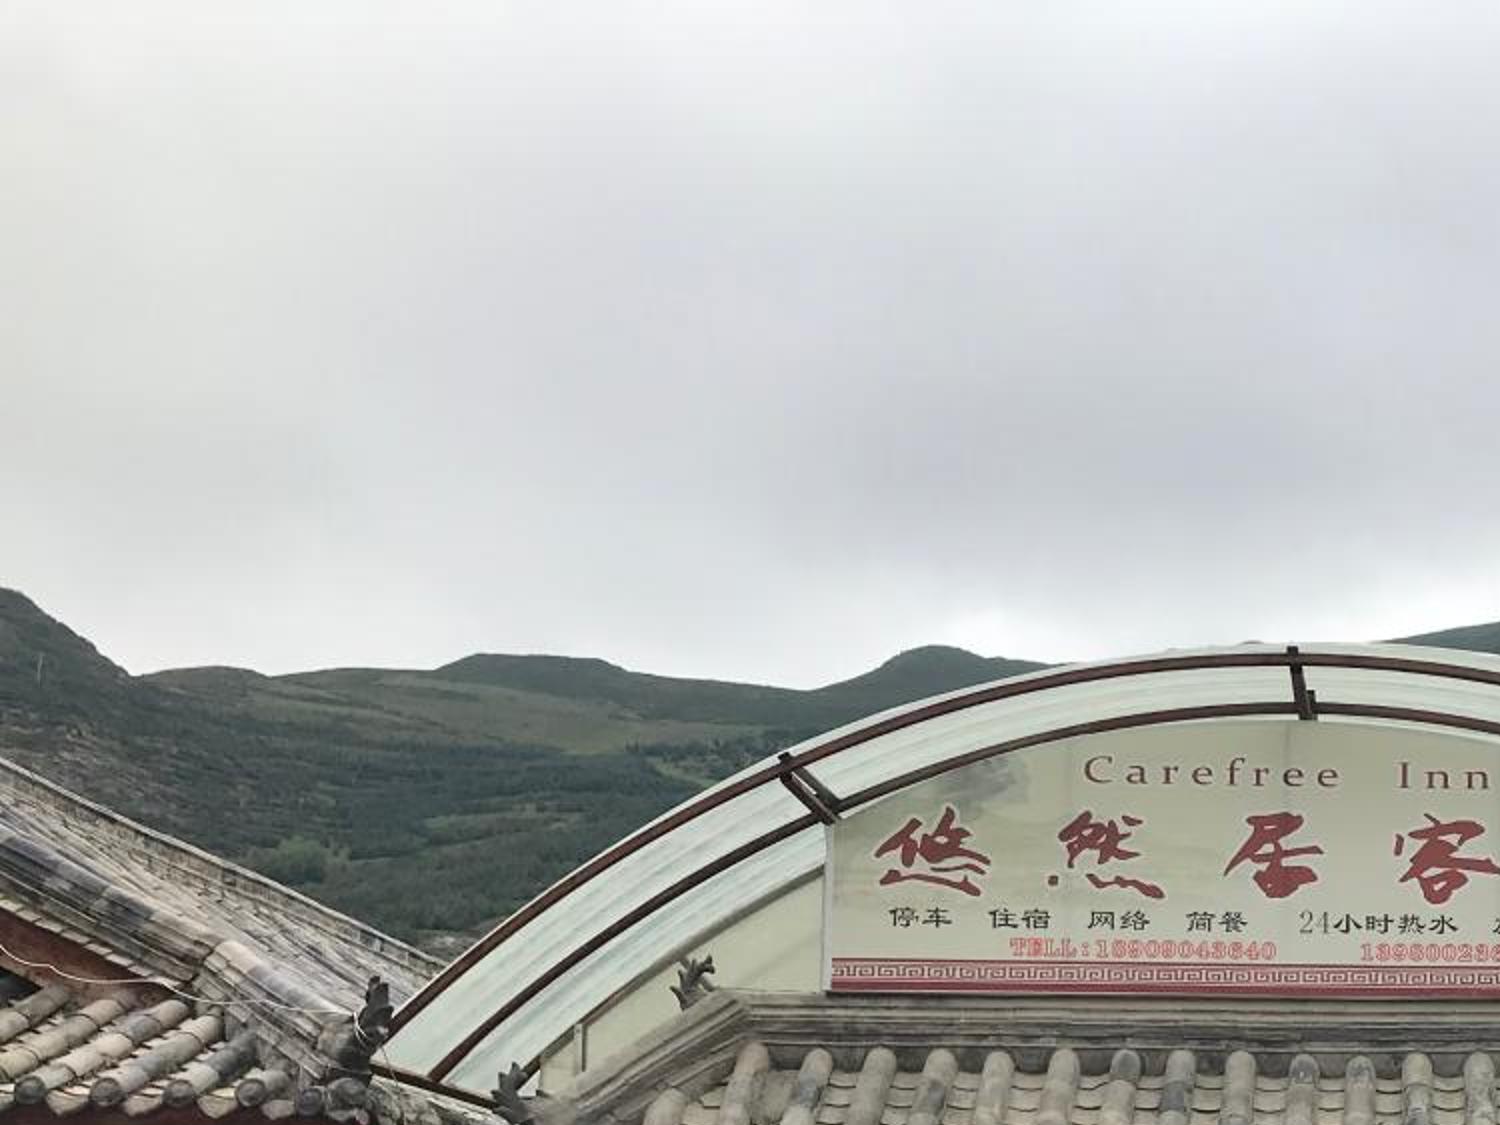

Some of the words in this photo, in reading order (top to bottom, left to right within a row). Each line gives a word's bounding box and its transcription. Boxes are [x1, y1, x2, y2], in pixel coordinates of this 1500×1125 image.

[1084, 755, 1340, 788] Carefree
[1395, 762, 1490, 789] Inn
[888, 907, 953, 929] 停车
[988, 908, 1051, 930] 住宿
[1087, 910, 1151, 931] 网络
[1185, 911, 1248, 933] 简餐
[1299, 911, 1459, 935] 24小时热水
